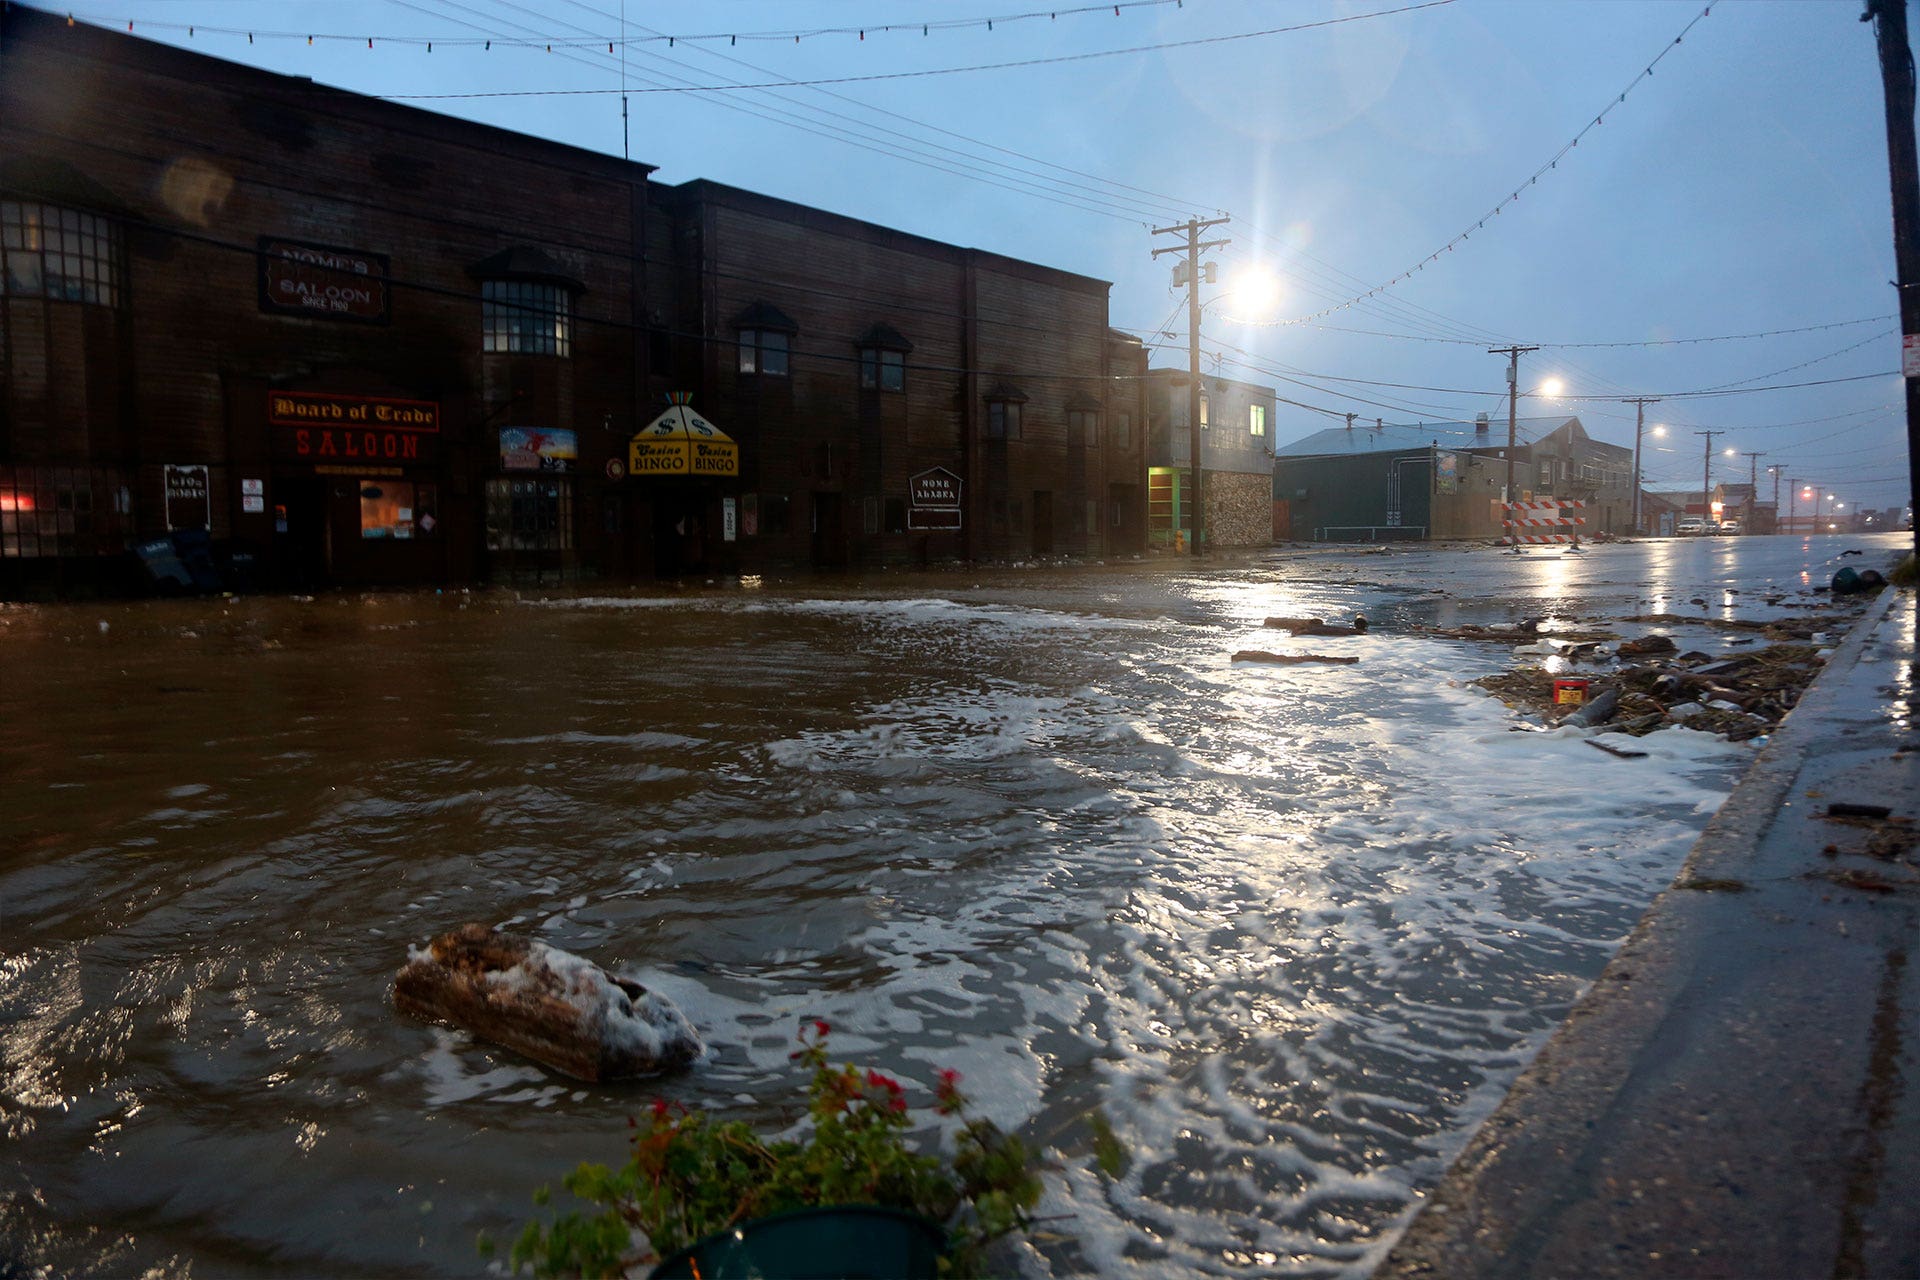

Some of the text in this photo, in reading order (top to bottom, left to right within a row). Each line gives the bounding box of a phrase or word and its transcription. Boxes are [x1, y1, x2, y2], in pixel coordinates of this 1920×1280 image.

[280, 278, 371, 304] SALOON
[274, 397, 434, 423] Board of Trade
[296, 429, 420, 459] SALOON
[636, 443, 681, 456] Casino
[697, 444, 732, 457] Casino
[634, 456, 684, 470] BINGO
[695, 457, 735, 471] BINGO
[917, 490, 955, 498] ALASKA
